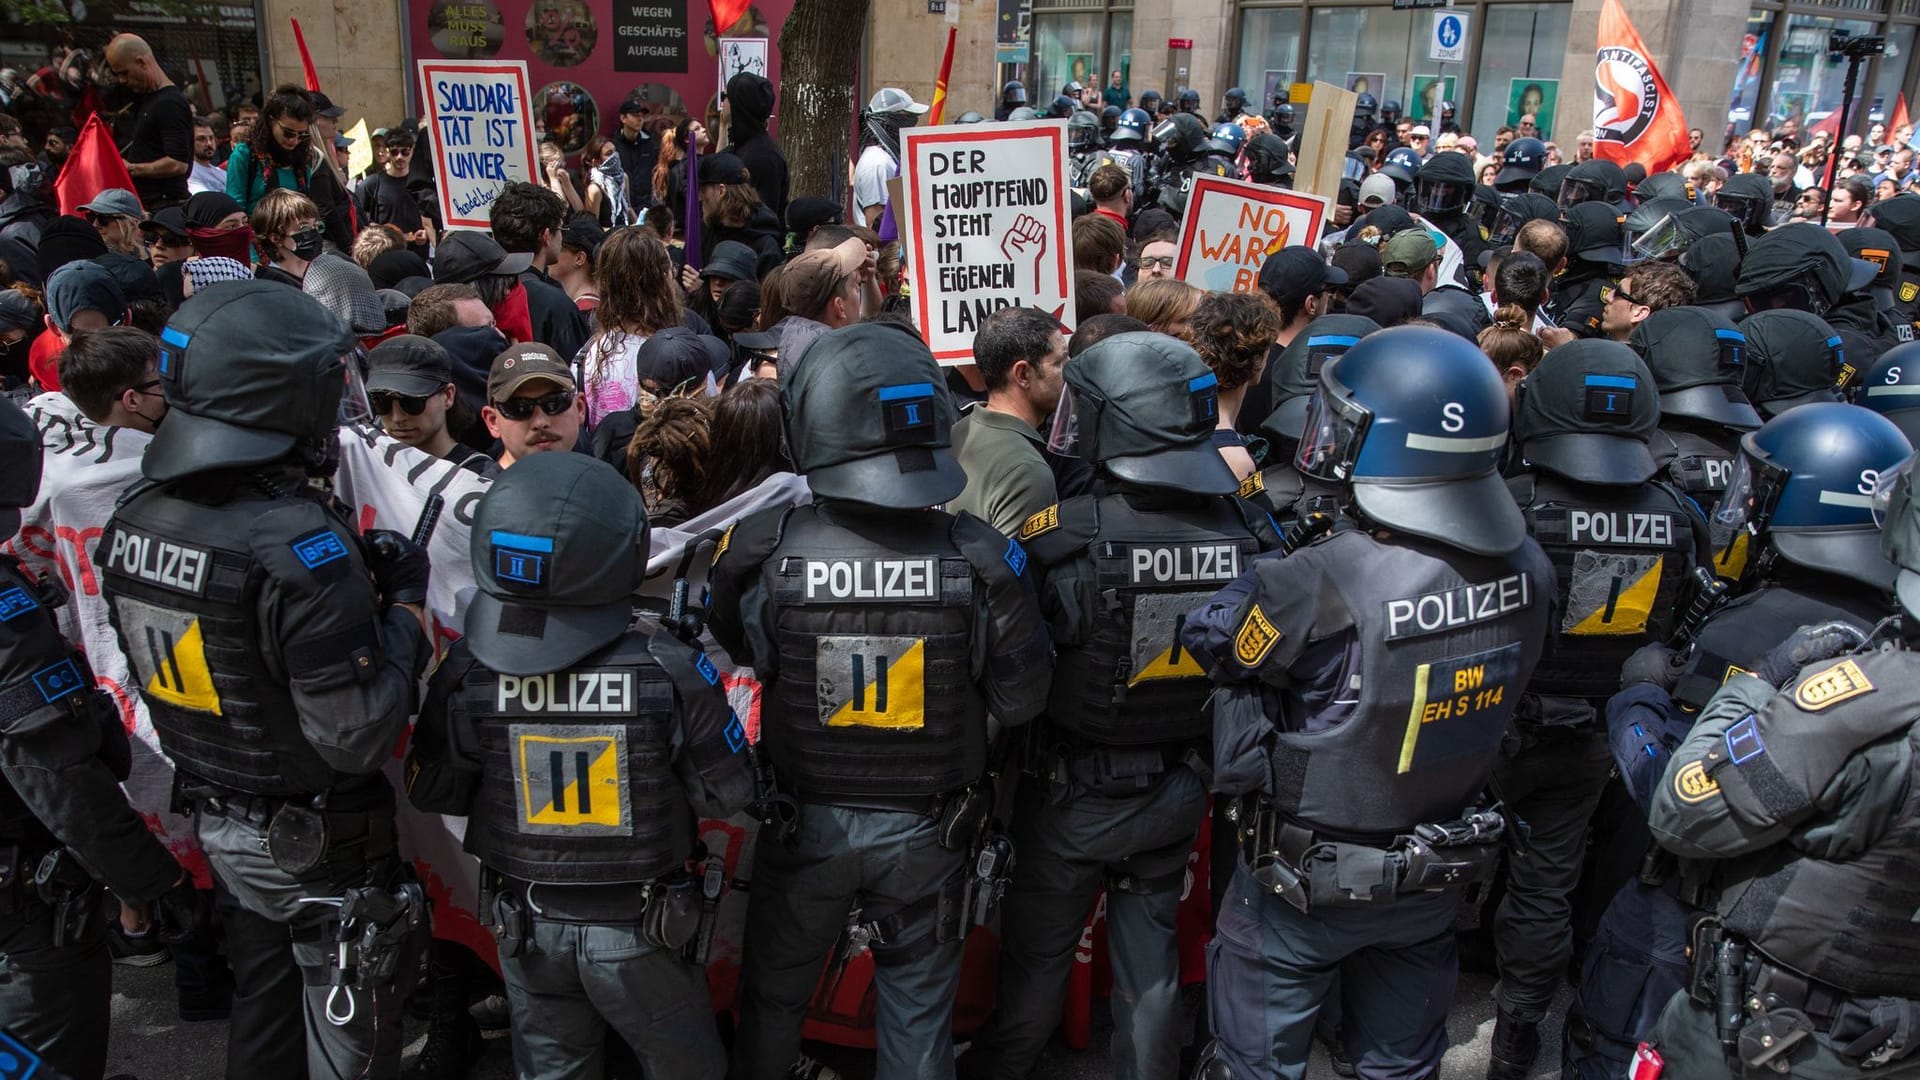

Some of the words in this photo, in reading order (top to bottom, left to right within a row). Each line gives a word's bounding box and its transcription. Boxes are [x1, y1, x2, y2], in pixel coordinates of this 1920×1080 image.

[446, 5, 488, 17] ALLES
[632, 7, 672, 18] WEGEN
[447, 21, 487, 32] MUSS
[618, 25, 686, 38] GESCHÄFTS-
[449, 36, 488, 48] RAUS
[627, 46, 678, 57] AUFGABE
[1437, 49, 1457, 58] ZONE
[437, 81, 520, 115] SOLIDARI-
[438, 115, 474, 147] TÄT
[485, 118, 517, 148] IST
[929, 150, 986, 176] DER
[933, 213, 992, 238] STEHT
[1239, 202, 1286, 236] NO
[937, 242, 963, 264] IM
[1200, 229, 1265, 268] WAR
[1884, 366, 1902, 385] S
[1441, 402, 1465, 432] S
[1857, 469, 1882, 495] S
[1571, 511, 1673, 545] POLIZEI
[107, 529, 207, 593] POLIZEI
[303, 537, 341, 562] BFE
[1132, 545, 1239, 583] POLIZEI
[806, 560, 934, 598] POLIZEI
[1388, 572, 1528, 636] POLIZEI
[1454, 664, 1485, 693] BW
[498, 673, 631, 712] POLIZEI
[1421, 699, 1451, 723] EH
[1455, 695, 1469, 717] S
[1475, 686, 1504, 711] 114
